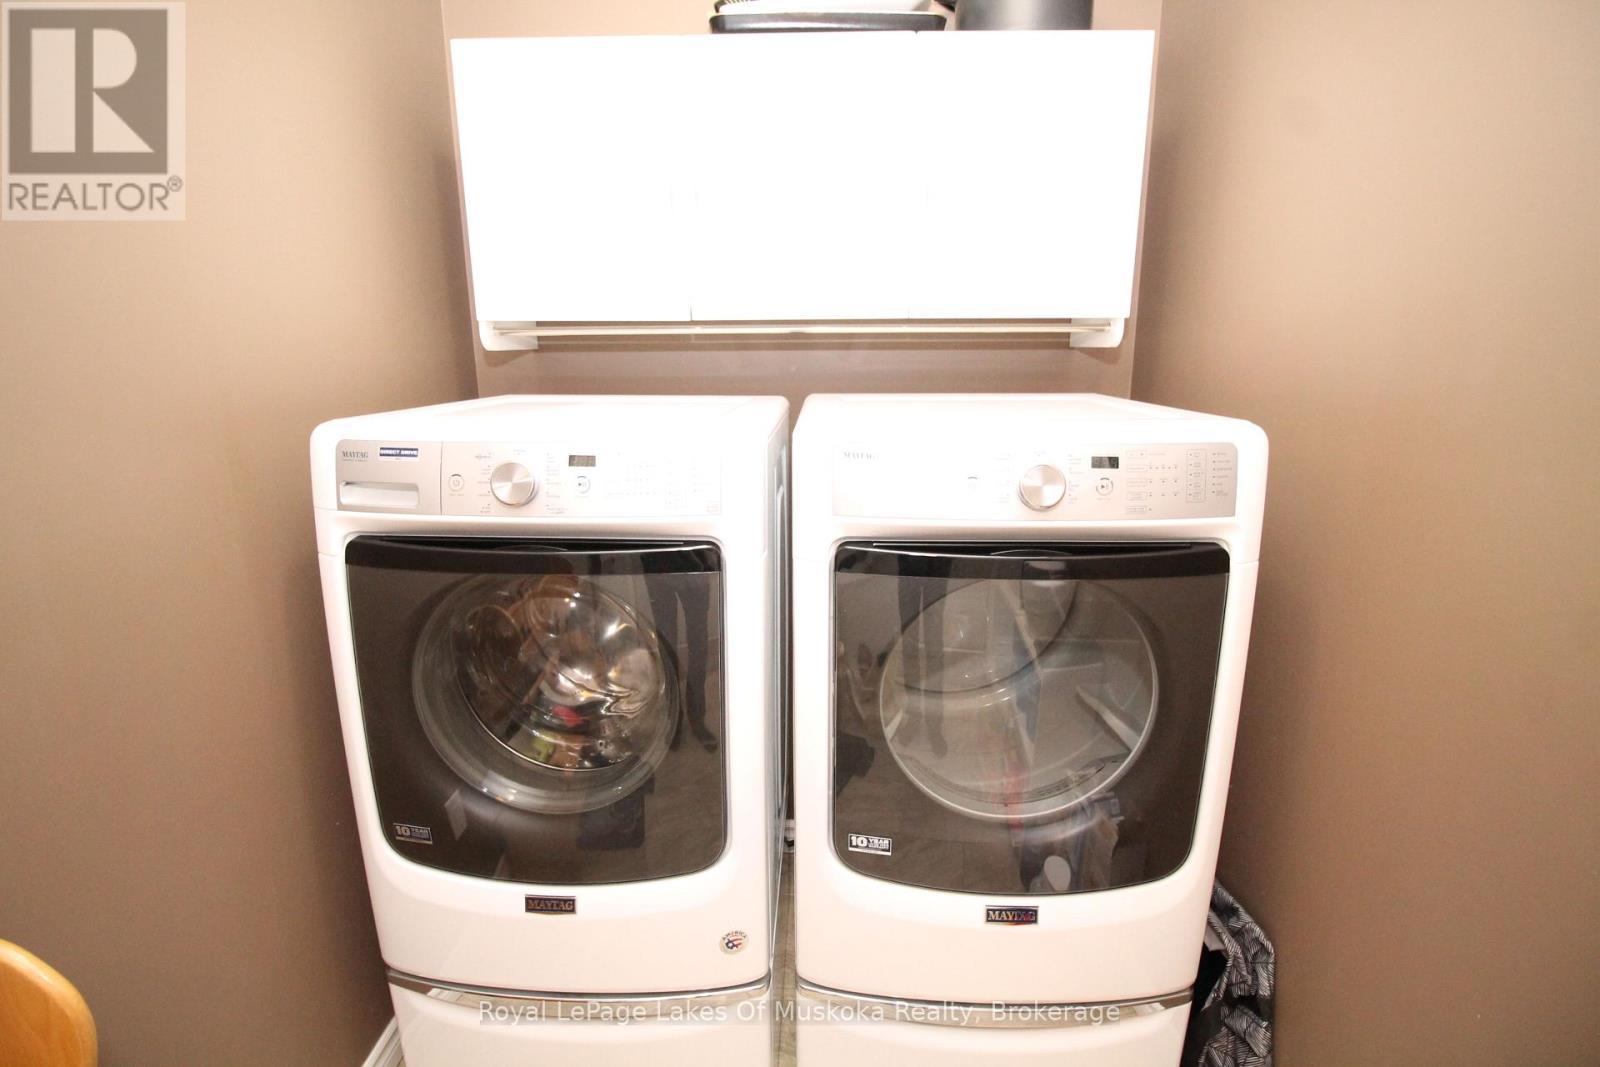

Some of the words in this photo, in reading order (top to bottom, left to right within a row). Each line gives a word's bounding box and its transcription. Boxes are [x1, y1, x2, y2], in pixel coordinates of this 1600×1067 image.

[342, 450, 368, 459] MAYTAG
[395, 825, 411, 837] 10
[850, 835, 868, 848] 10
[527, 899, 574, 911] MAYTAG
[987, 910, 1036, 921] MAYTAG
